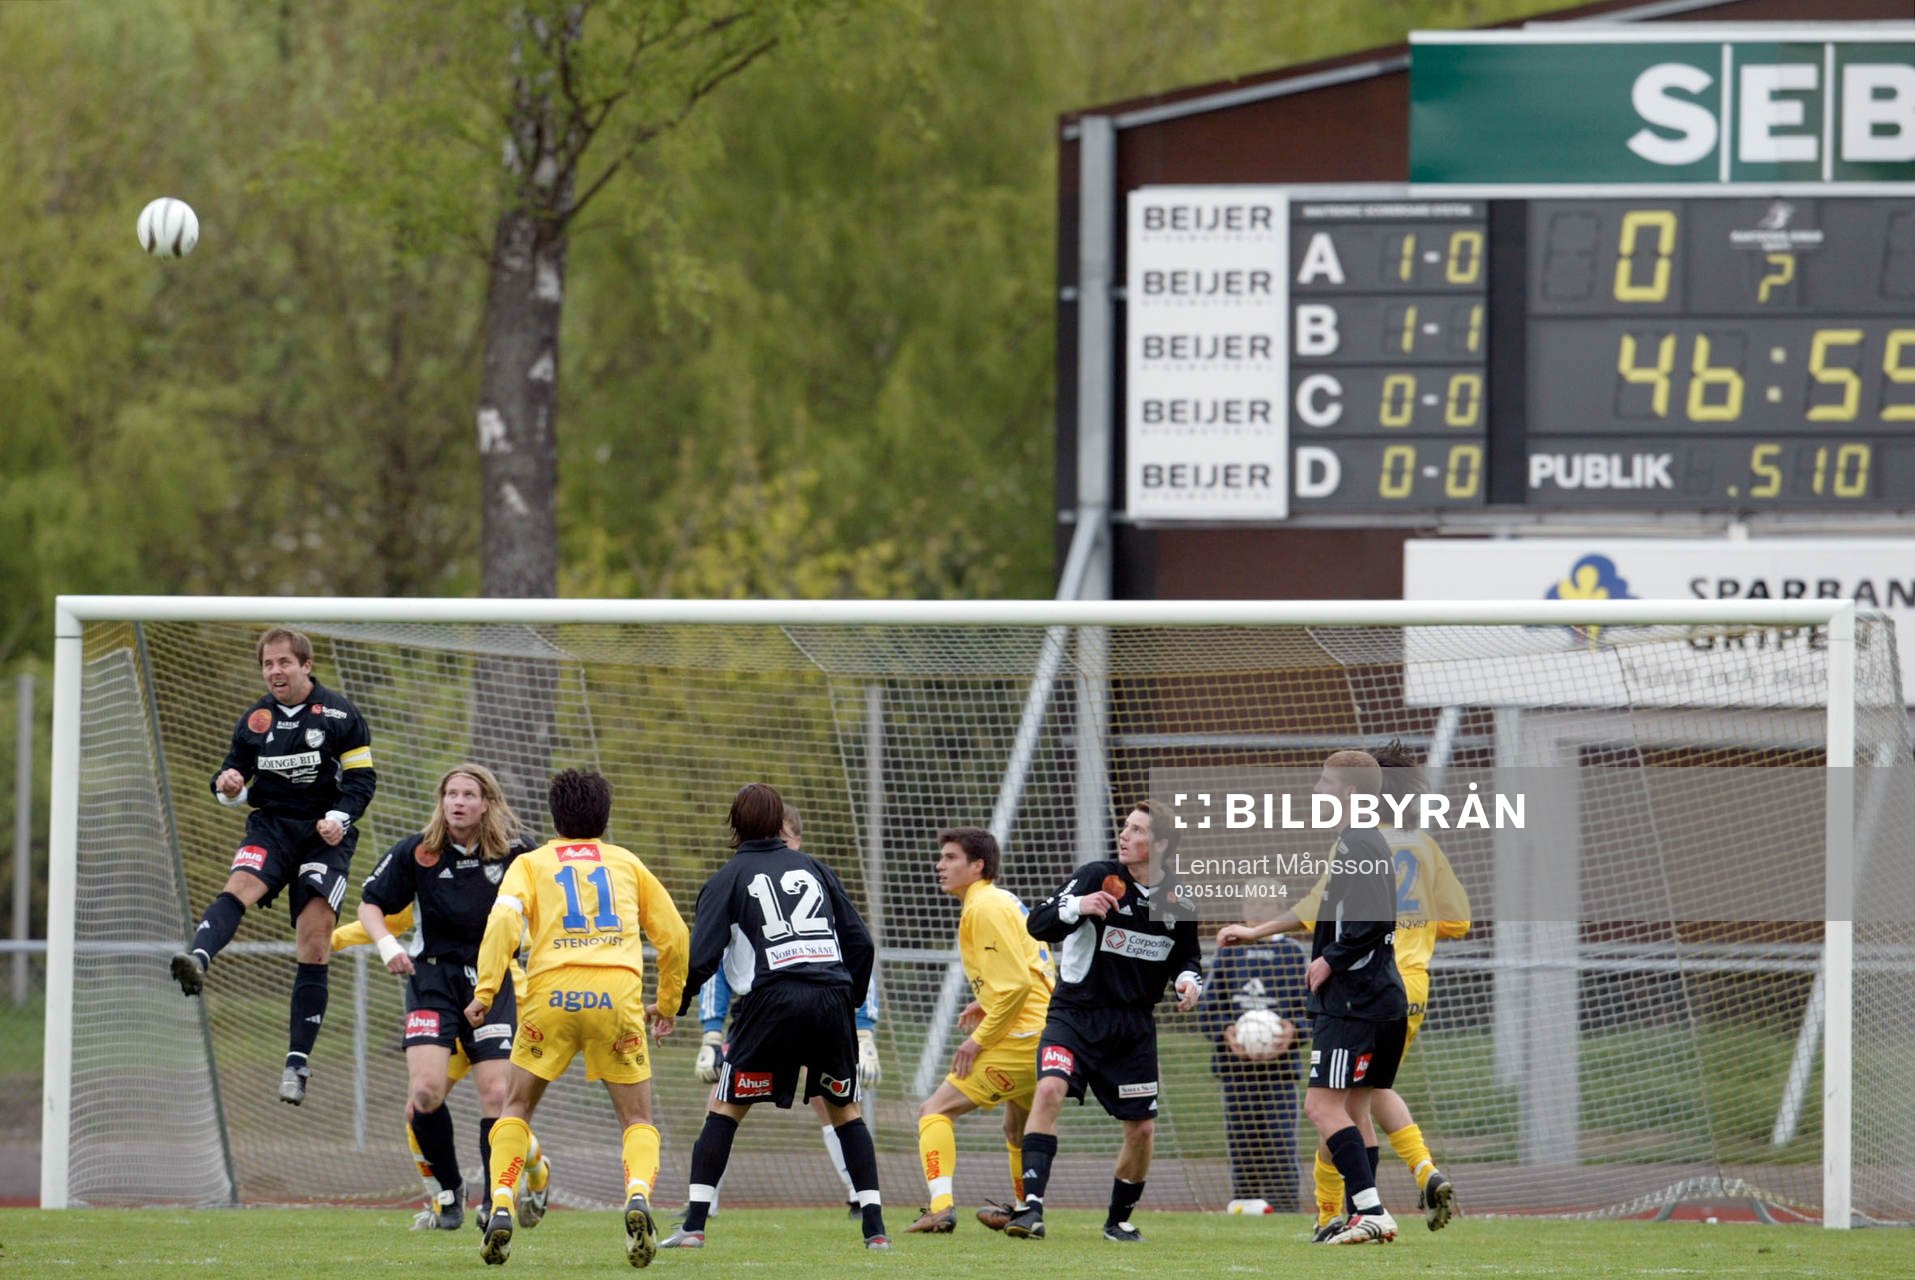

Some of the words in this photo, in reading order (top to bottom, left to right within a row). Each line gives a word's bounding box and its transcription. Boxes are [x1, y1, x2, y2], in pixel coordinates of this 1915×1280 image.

[1626, 62, 1915, 165] SEB
[1143, 205, 1272, 231] BEIJER
[1297, 232, 1345, 284] A
[1143, 270, 1272, 296] BEIJER
[1296, 304, 1340, 356] B
[1142, 334, 1272, 360] BEIJER
[1141, 399, 1271, 425] BEIJER
[1295, 373, 1343, 428] C
[1141, 463, 1271, 489] BEIJER
[1295, 445, 1341, 498] D
[1529, 453, 1674, 490] PUBLIK
[554, 865, 623, 934] 11
[747, 868, 832, 941] 12
[1126, 944, 1159, 957] Express
[1129, 935, 1171, 949] Corporate
[549, 990, 613, 1012] agDA
[408, 1013, 437, 1028] Åhus
[738, 1073, 770, 1089] Åhus
[498, 1156, 525, 1188] Allers
